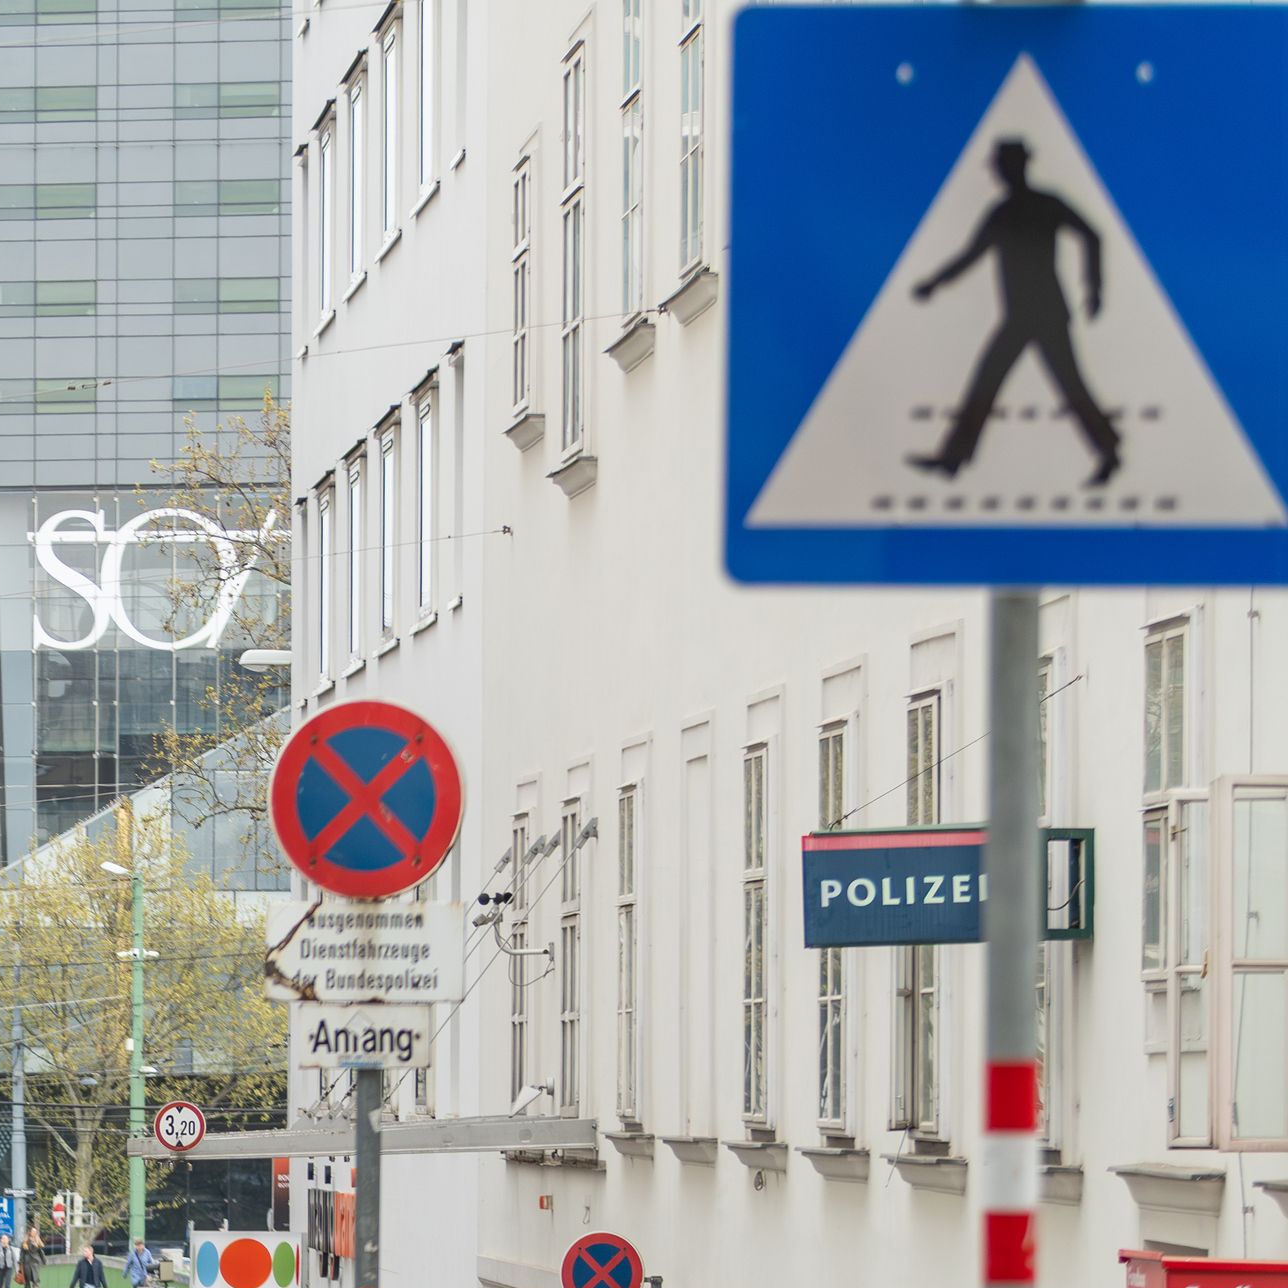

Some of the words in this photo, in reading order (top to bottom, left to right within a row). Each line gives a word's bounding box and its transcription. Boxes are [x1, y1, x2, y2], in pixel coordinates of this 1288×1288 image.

[820, 873, 990, 908] POLIZEI
[307, 912, 424, 933] ausgenommen
[300, 938, 430, 964] Dienstfahrzeuge
[292, 969, 318, 990] der
[325, 968, 439, 995] Bundespolizei
[165, 1114, 196, 1139] 3,20
